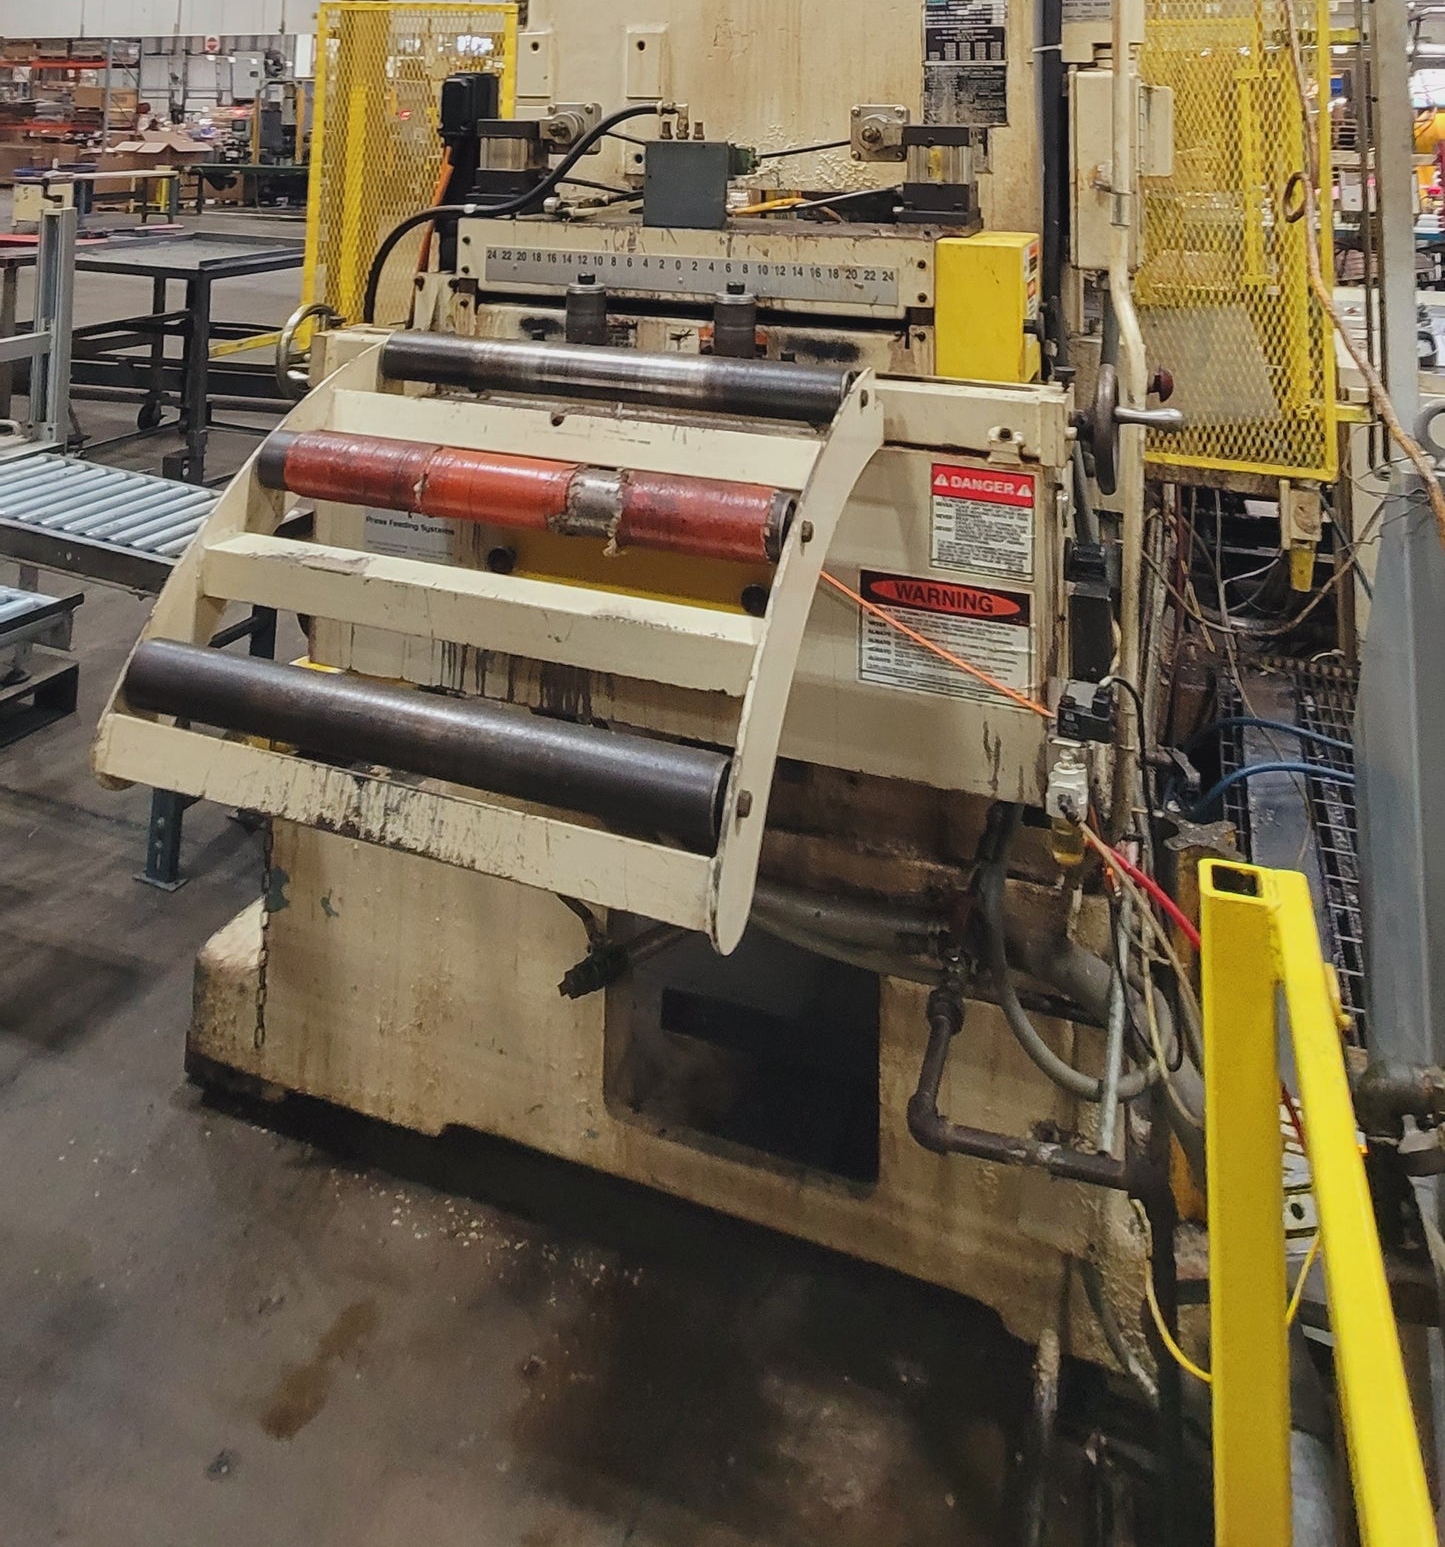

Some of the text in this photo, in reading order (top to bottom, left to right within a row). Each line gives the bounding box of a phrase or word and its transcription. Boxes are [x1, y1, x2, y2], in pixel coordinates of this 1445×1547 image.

[487, 250, 894, 282] 24 22 20 18 16 14 12 10 8 6 4 2 0 2 4 6 8 10 12 14 16 18 20 22 24
[950, 475, 1015, 495] DANGER
[366, 515, 455, 535] Press Feeding Systems
[894, 582, 994, 614] WARNING
